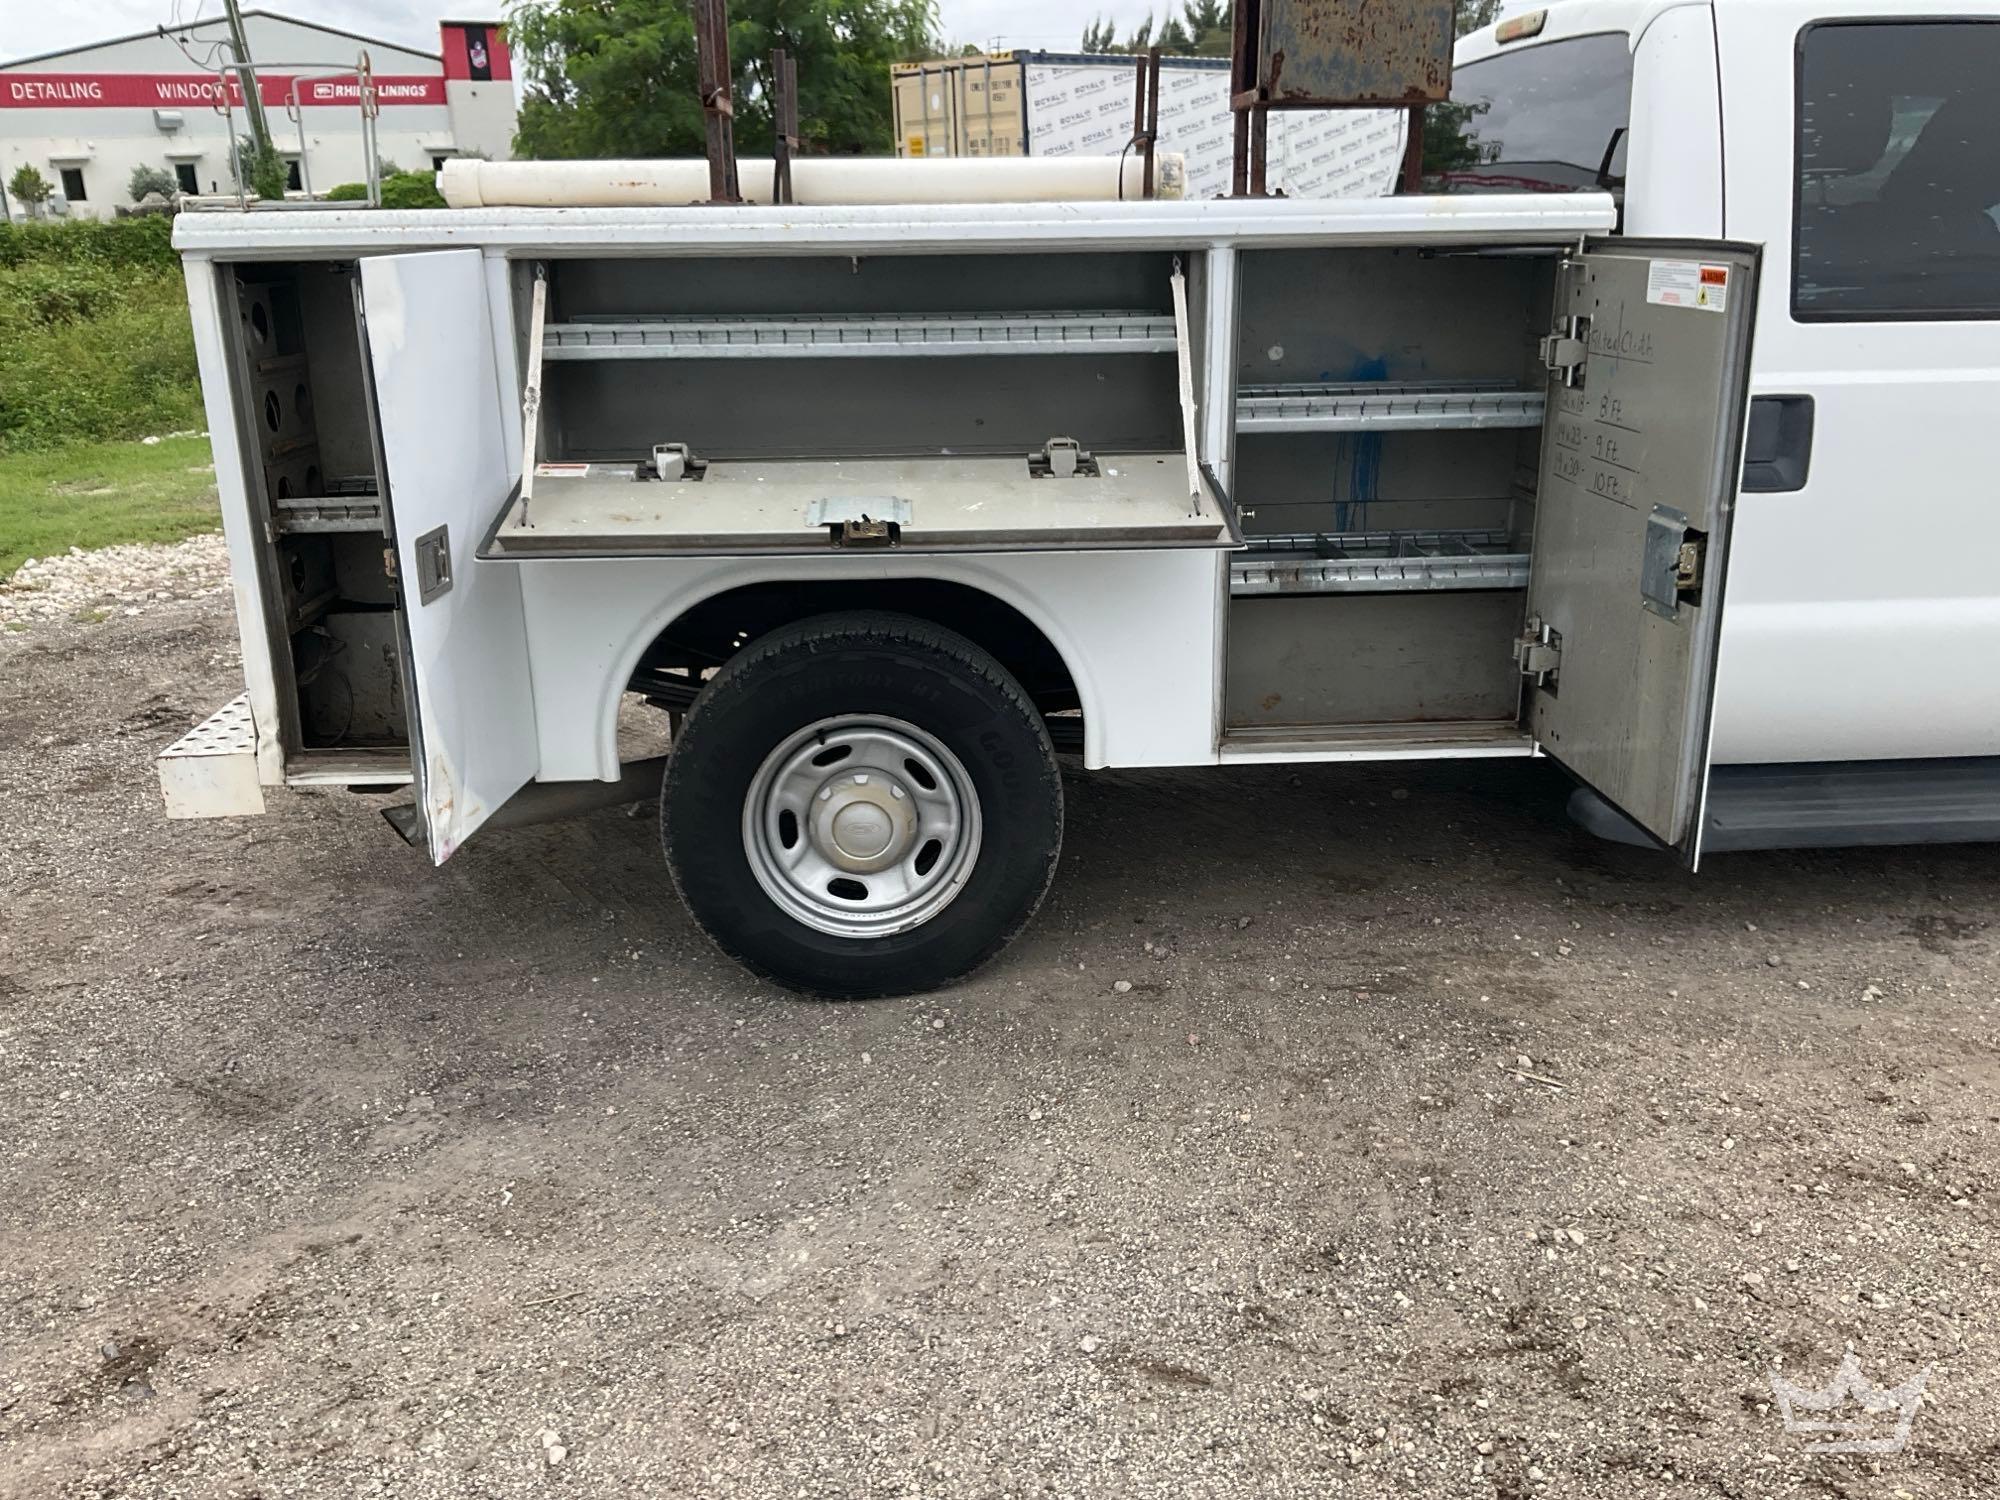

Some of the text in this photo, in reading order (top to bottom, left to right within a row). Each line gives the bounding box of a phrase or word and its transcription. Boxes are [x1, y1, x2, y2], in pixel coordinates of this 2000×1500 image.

[10, 82, 102, 99] DETAILING
[378, 85, 427, 97] LININGS
[1600, 395, 1608, 417] 8
[1596, 435, 1602, 457] 9
